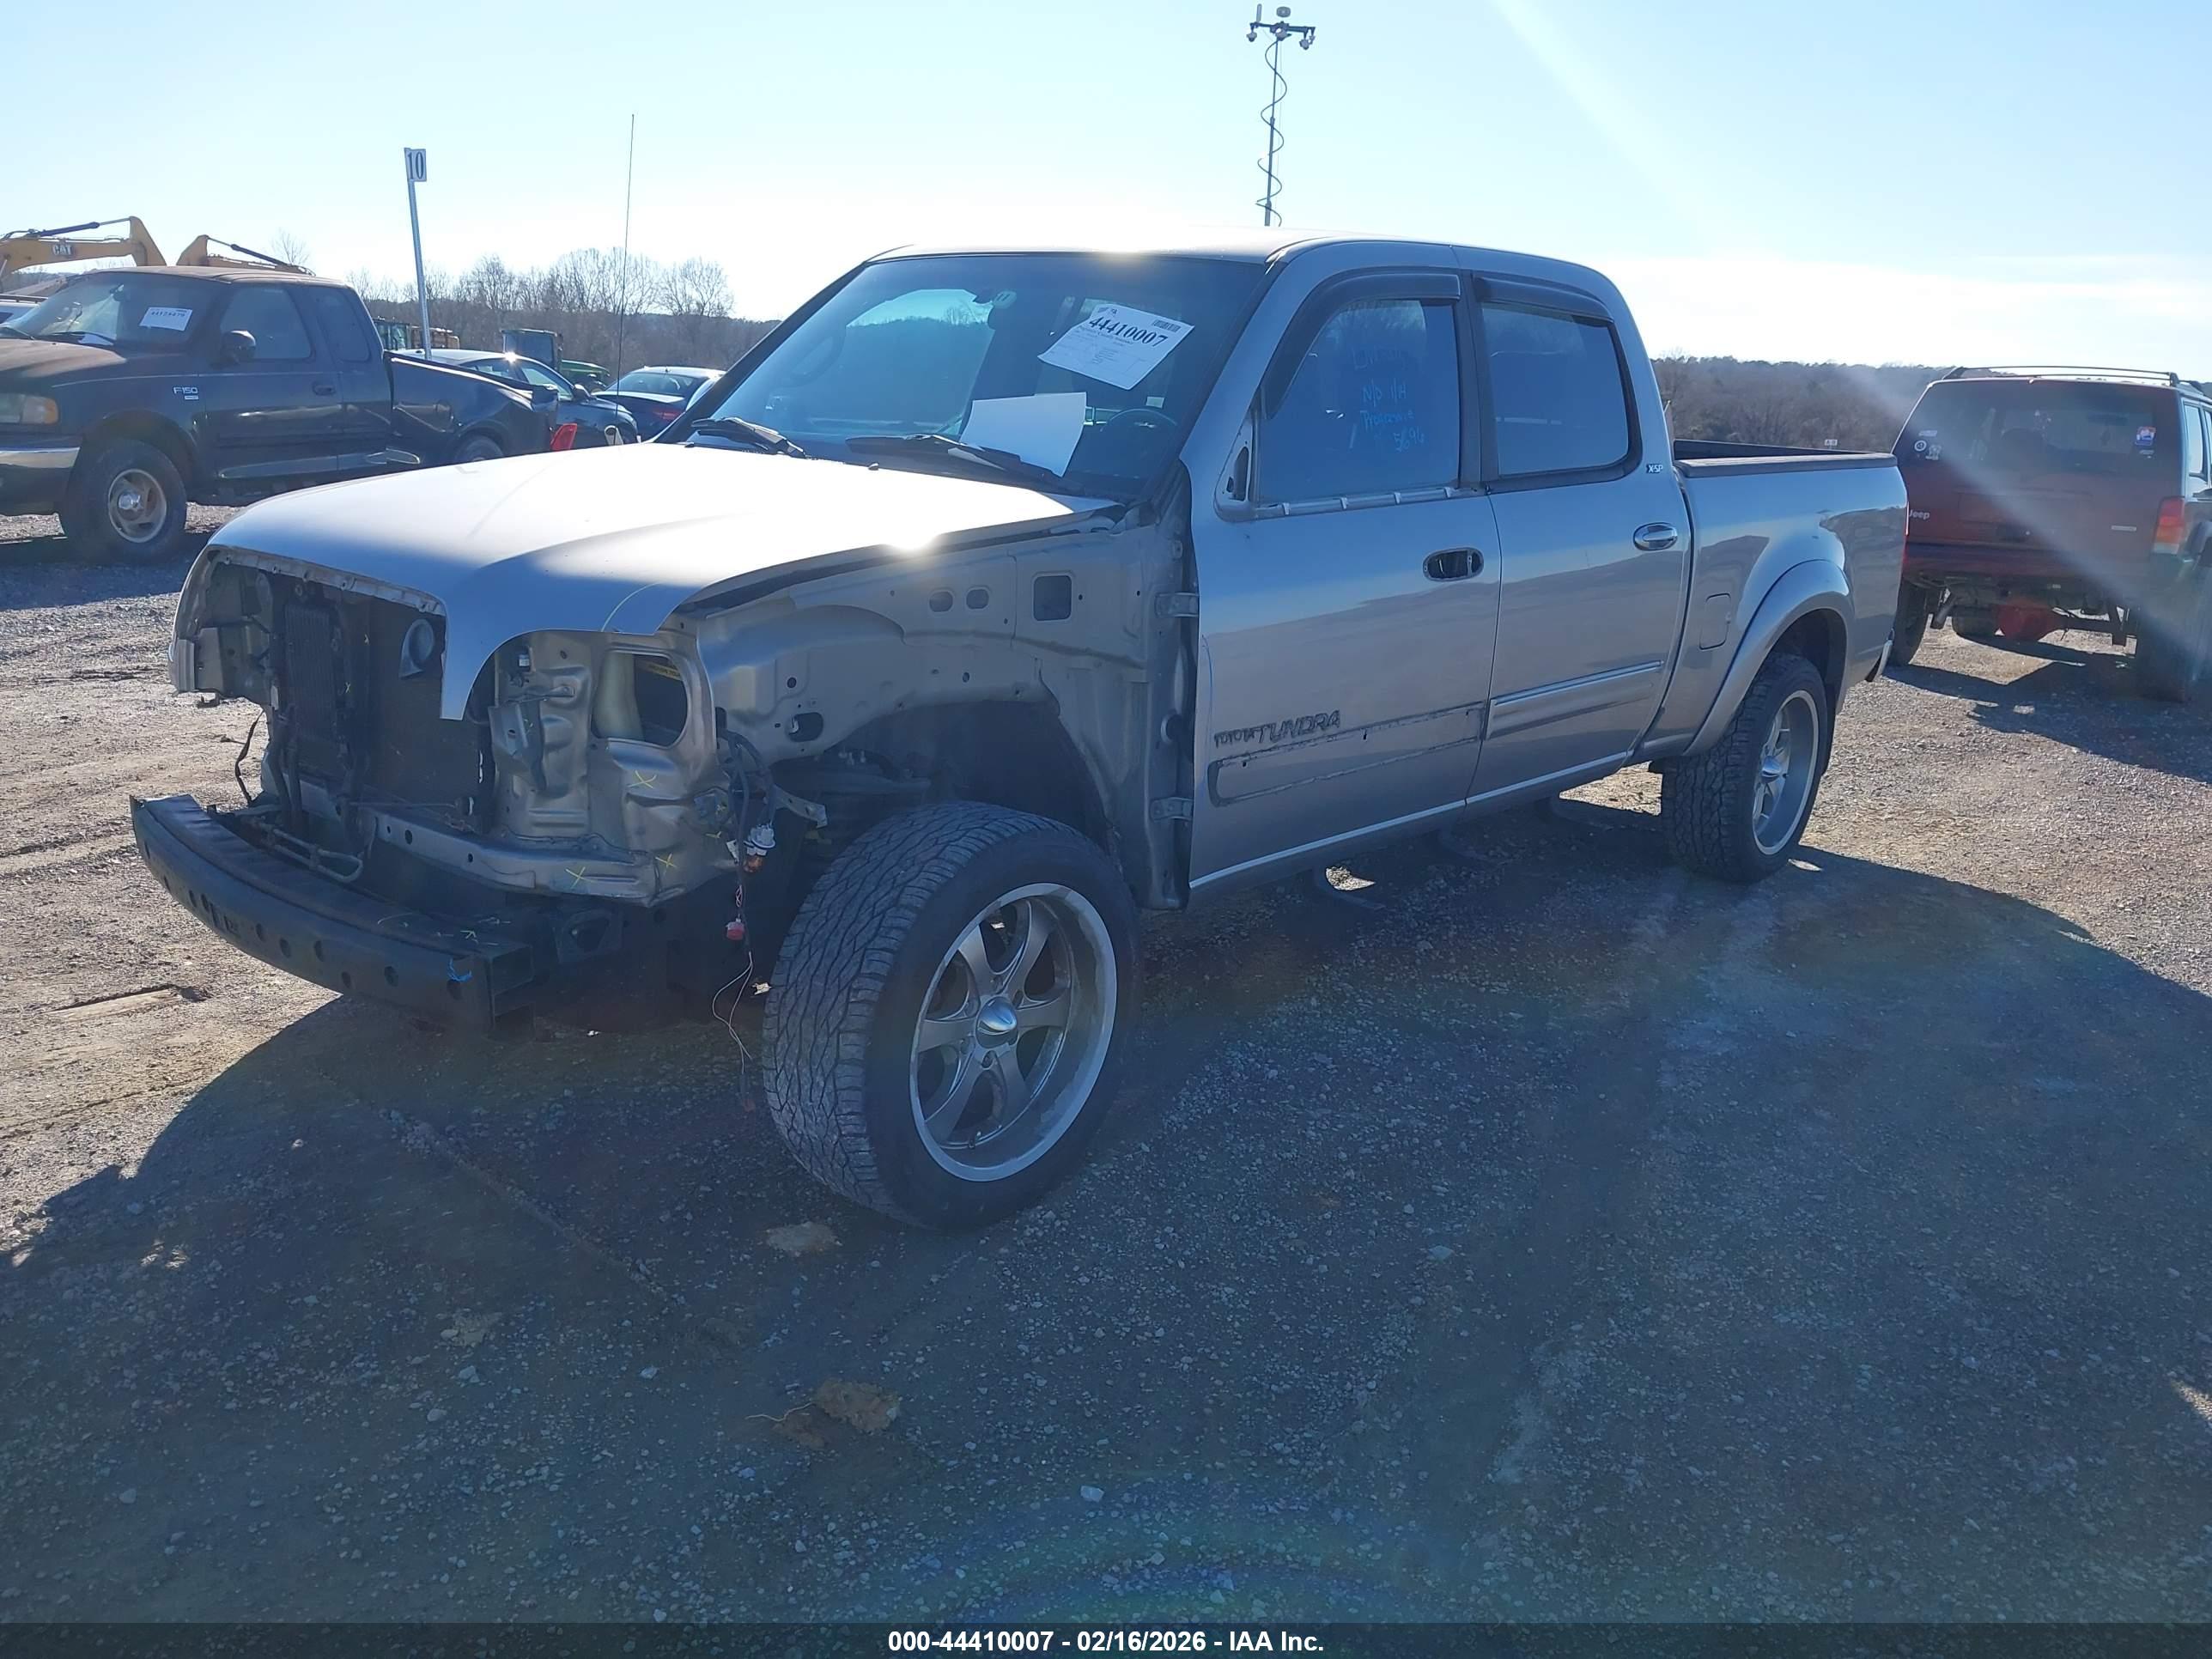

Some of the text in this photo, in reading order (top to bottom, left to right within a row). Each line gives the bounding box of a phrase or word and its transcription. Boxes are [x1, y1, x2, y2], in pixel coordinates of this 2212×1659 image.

[407, 151, 424, 179] 10
[52, 244, 71, 256] CAT
[1089, 316, 1169, 347] 44410007
[1909, 509, 1930, 520] Jeep
[1255, 709, 1340, 744] TUNDRA
